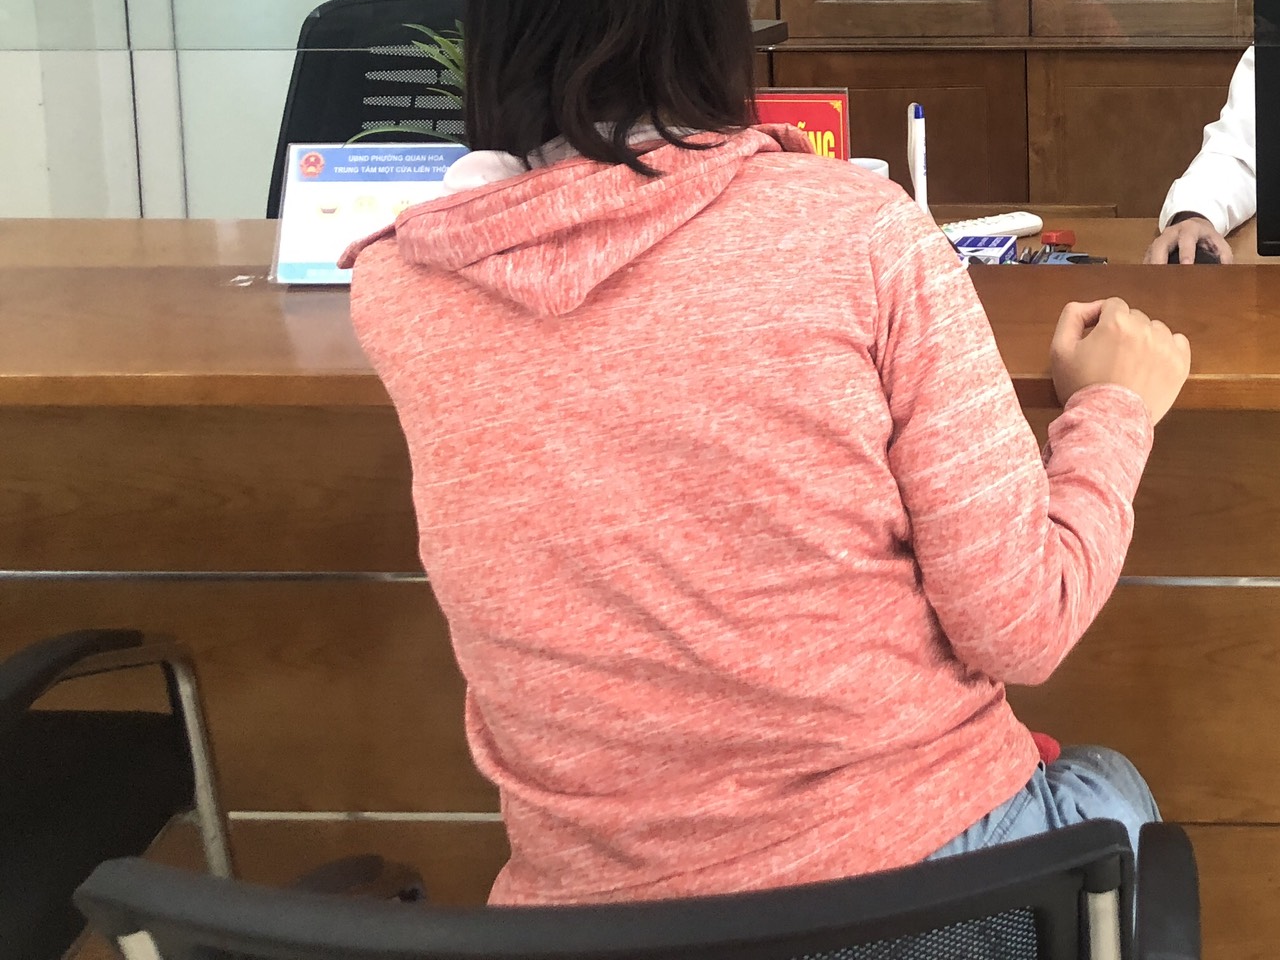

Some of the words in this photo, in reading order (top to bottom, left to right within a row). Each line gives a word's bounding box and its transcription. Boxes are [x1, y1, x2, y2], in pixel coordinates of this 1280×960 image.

[348, 154, 369, 163] UBND
[370, 153, 404, 163] PHƯỜNG
[405, 154, 426, 162] QUAN
[334, 166, 359, 174] TRUNG
[361, 165, 377, 174] TÂM
[378, 165, 394, 175] MỘT
[413, 165, 431, 174] LIÊN
